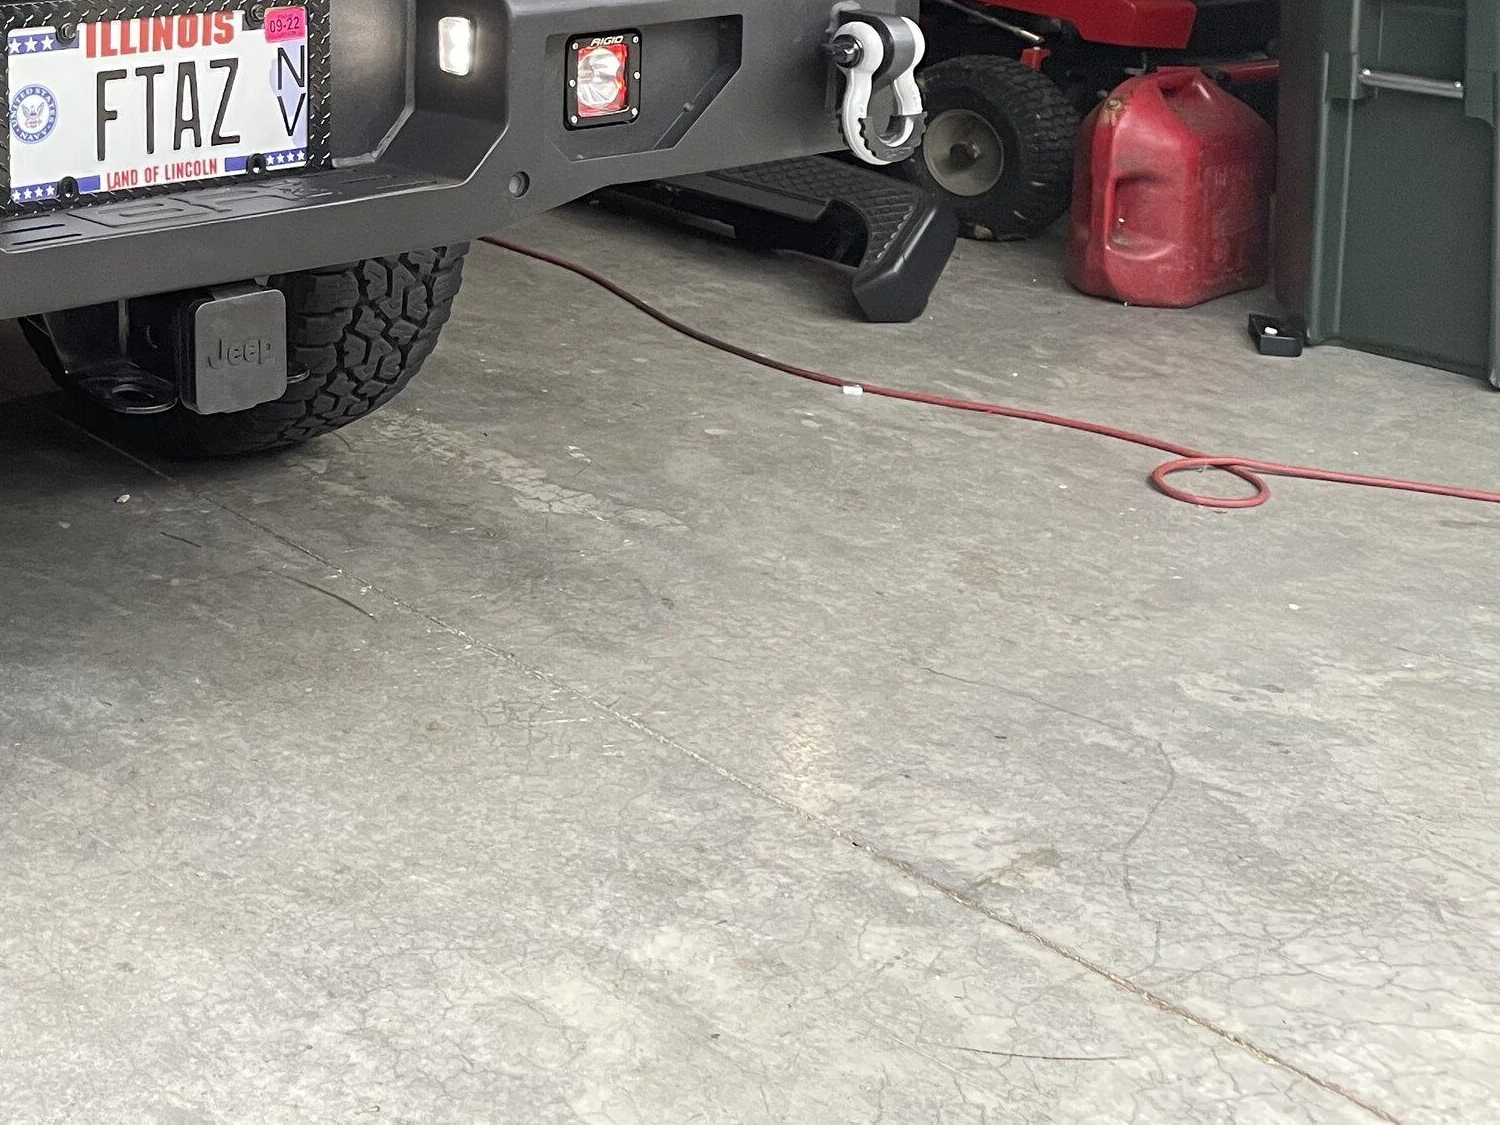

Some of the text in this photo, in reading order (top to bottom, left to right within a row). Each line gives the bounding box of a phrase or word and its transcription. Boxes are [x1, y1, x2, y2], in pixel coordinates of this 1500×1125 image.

[86, 10, 235, 58] ILLINOIS
[269, 16, 300, 33] 09-22
[590, 35, 624, 47] RIGID
[97, 58, 241, 162] FTAZ
[107, 158, 217, 191] LAND OF LINCOLN
[206, 338, 276, 370] Jeep
